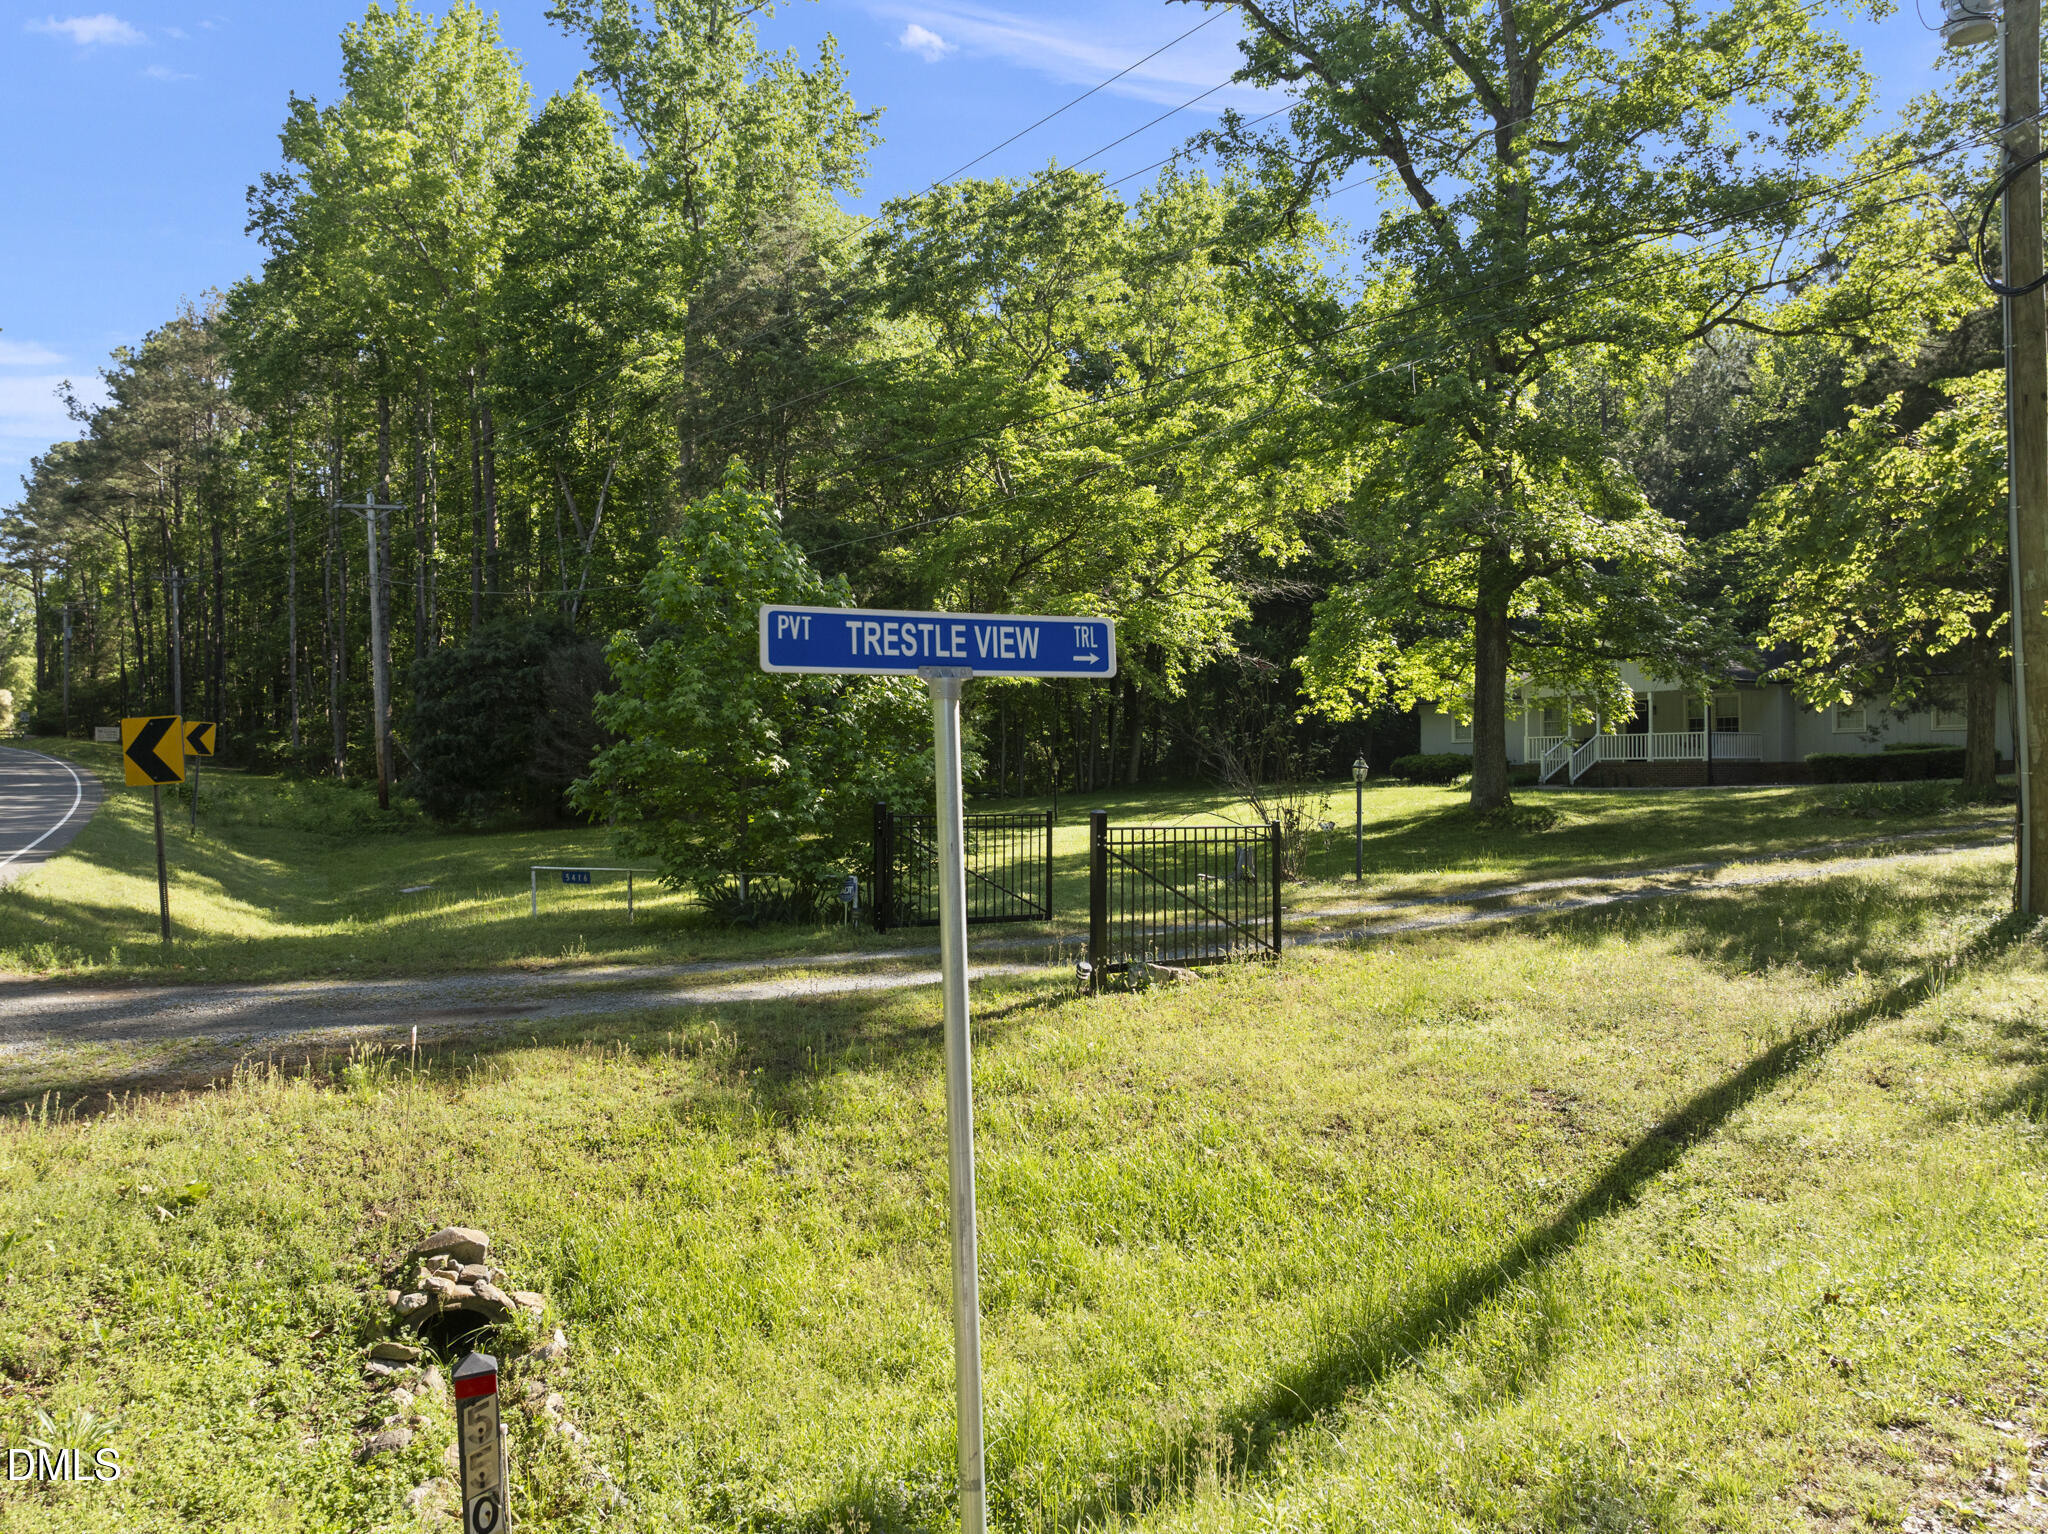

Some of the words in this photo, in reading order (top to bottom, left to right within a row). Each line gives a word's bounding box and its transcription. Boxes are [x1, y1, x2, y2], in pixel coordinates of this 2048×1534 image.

[777, 615, 812, 641] PVT
[846, 620, 967, 658] TRESTLE
[974, 625, 1040, 659] VIEW
[1073, 625, 1098, 649] TRL
